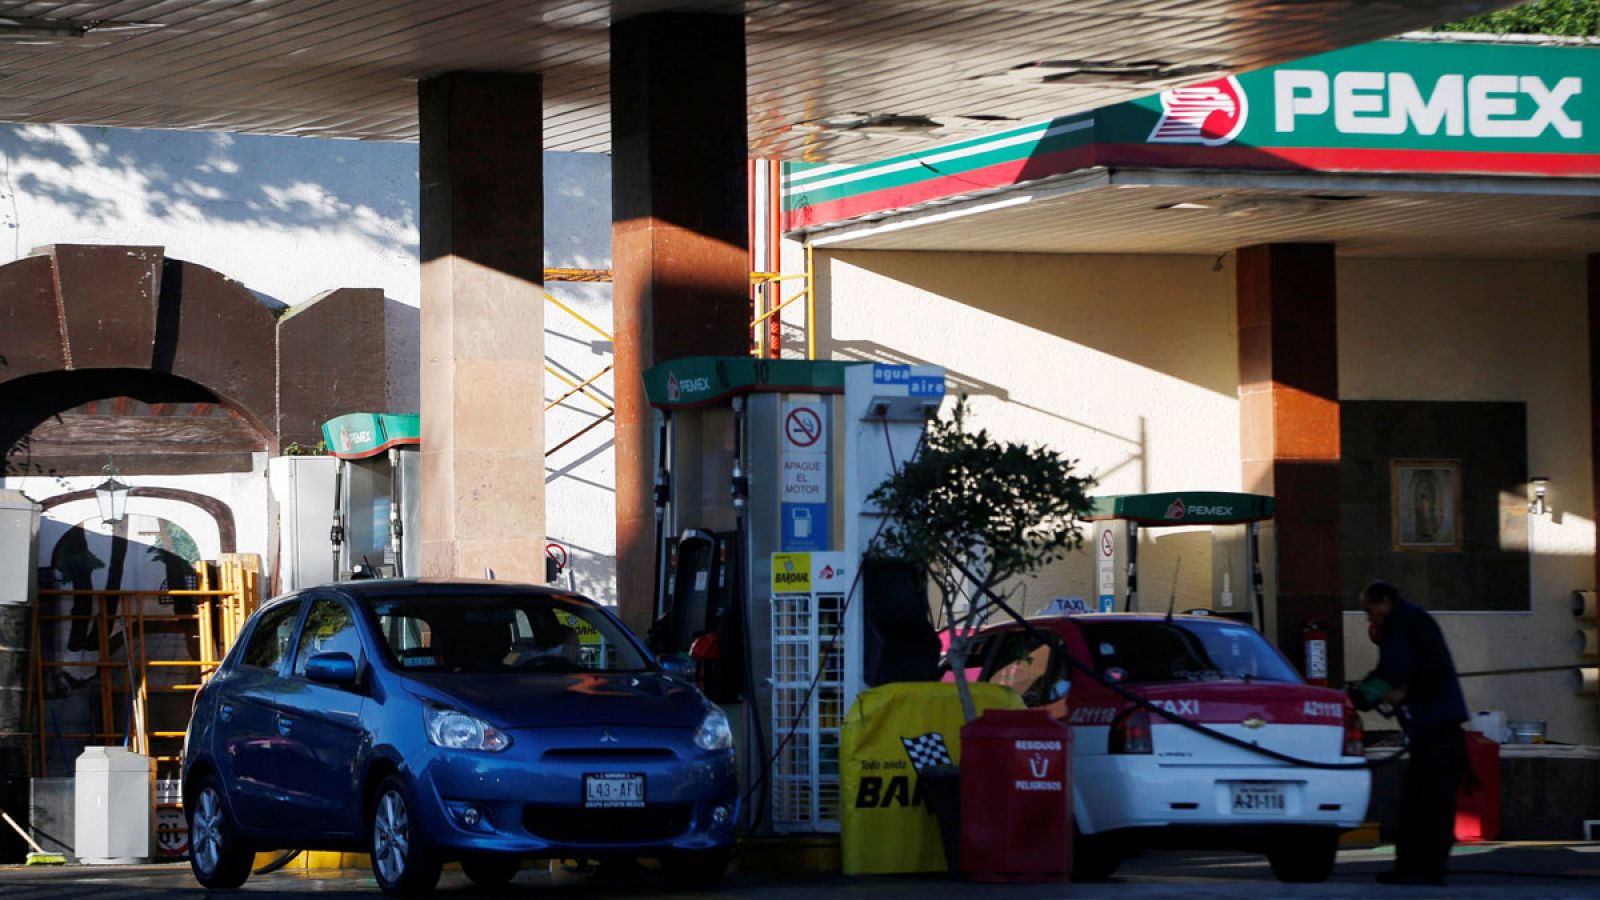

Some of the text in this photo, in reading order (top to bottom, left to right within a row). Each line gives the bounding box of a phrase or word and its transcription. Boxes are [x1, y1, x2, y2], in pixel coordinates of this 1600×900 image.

[1273, 69, 1583, 139] PEMEX
[875, 368, 910, 381] agua
[679, 376, 710, 393] PEMEX
[911, 379, 944, 392] aire
[348, 431, 371, 444] PEMEX
[784, 461, 822, 471] APAGUE
[796, 473, 807, 482] EL
[785, 484, 819, 494] MOTOR
[1187, 505, 1233, 516] PEMEX
[1056, 599, 1085, 611] TAXI
[1149, 699, 1199, 716] TAXI
[1015, 740, 1062, 750] RESIDUOS
[588, 783, 642, 798] L43-AFU
[1015, 780, 1062, 791] PELIGROSOS
[1232, 794, 1284, 809] A-21-118
